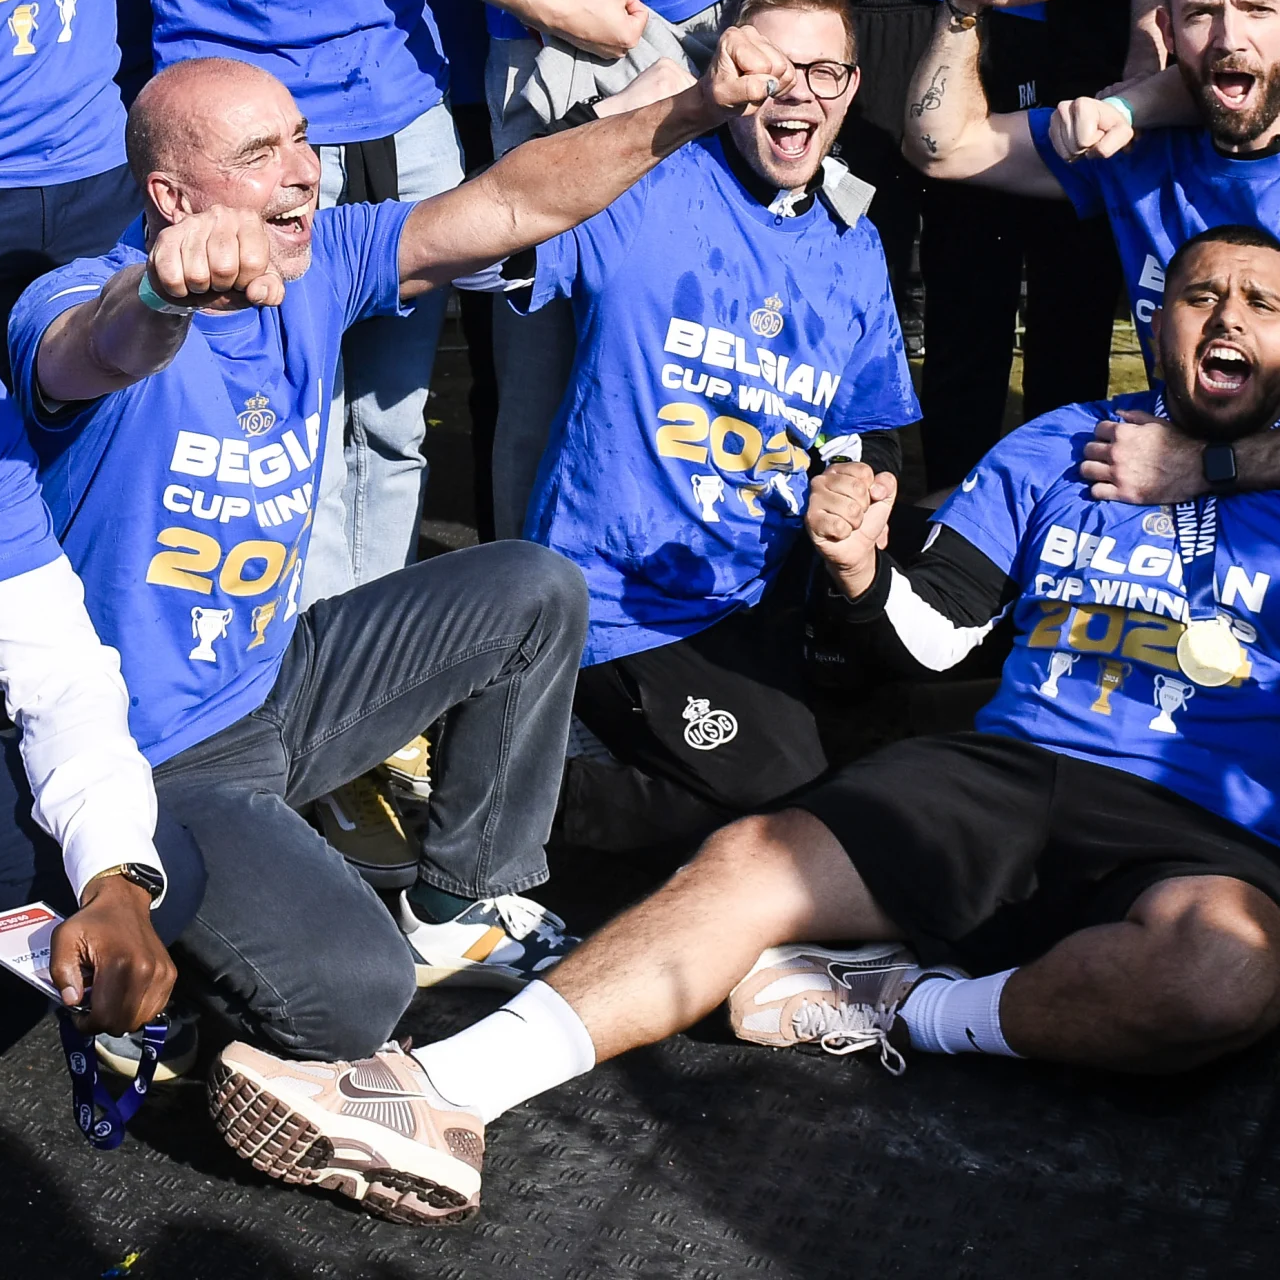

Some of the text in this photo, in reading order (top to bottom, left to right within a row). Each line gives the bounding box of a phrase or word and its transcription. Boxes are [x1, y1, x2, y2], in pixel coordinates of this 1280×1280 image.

[661, 363, 732, 398] CUP
[664, 317, 841, 408] BELGIAN
[163, 484, 251, 523] CUP
[688, 715, 733, 746] USG
